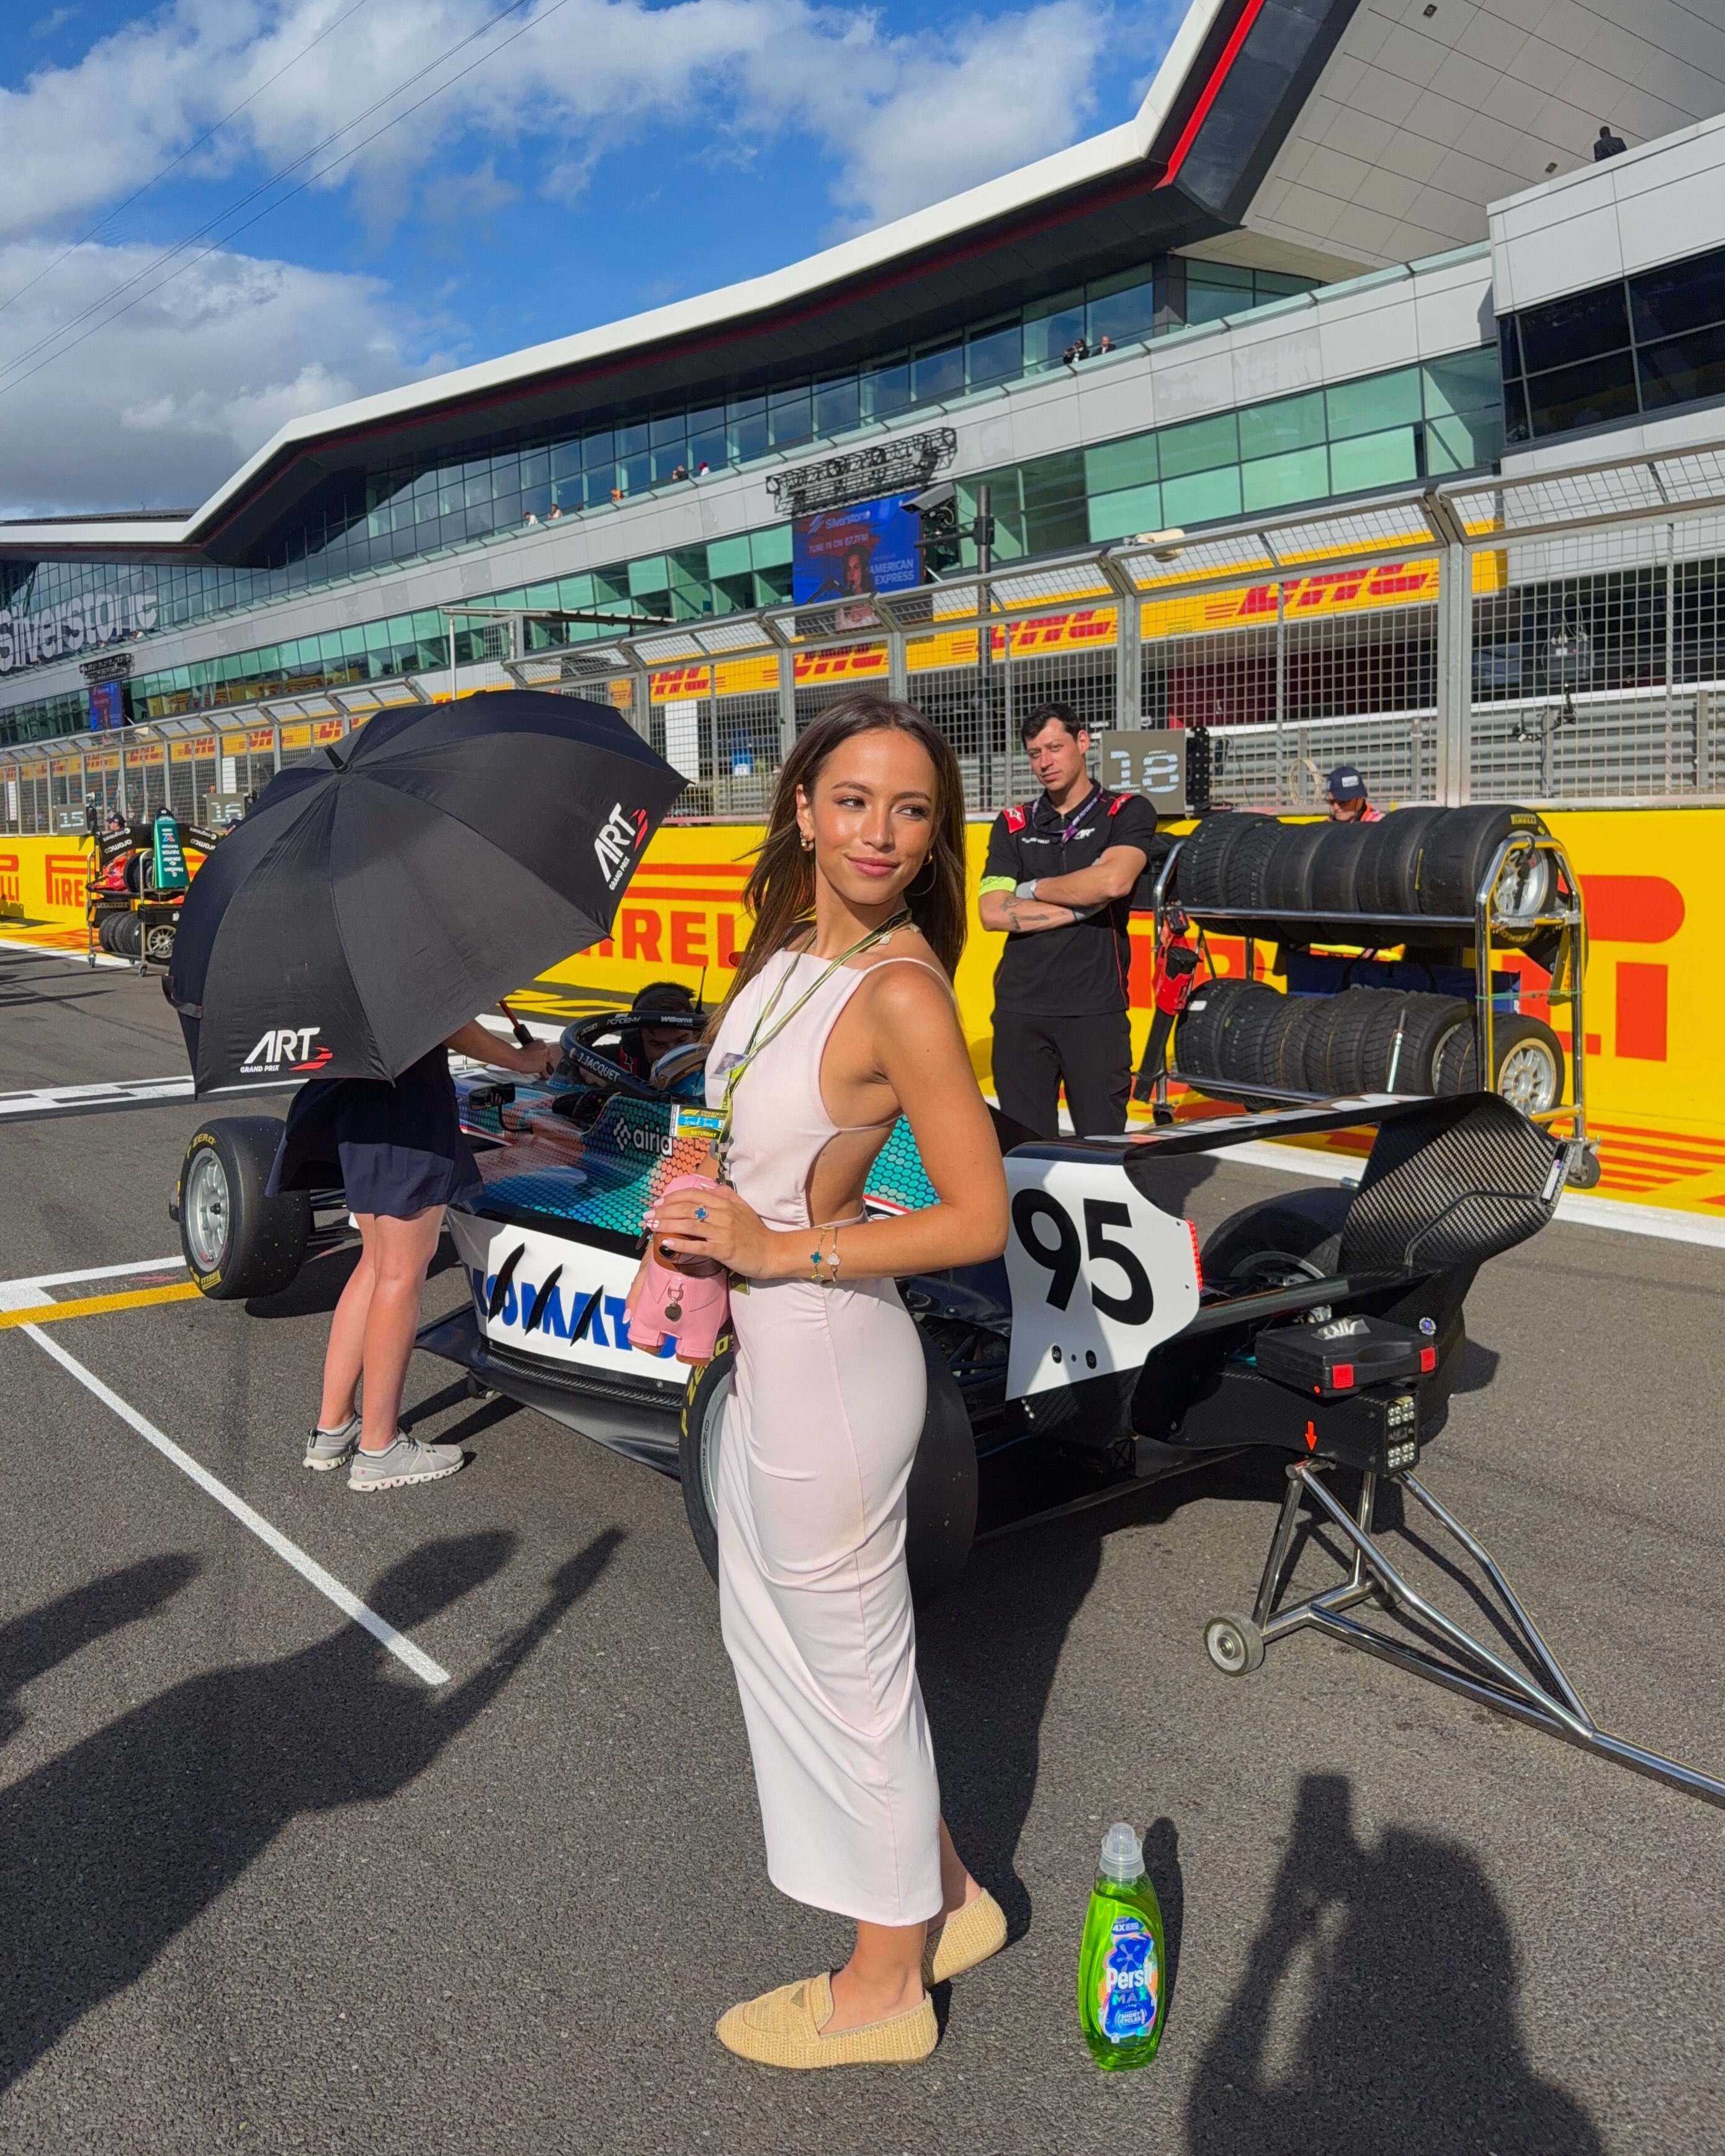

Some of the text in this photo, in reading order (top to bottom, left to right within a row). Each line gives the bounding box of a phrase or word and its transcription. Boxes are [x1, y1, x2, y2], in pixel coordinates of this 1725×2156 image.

[826, 511, 870, 529] Silverstone
[870, 559, 913, 574] AMERICAN
[874, 570, 914, 584] EXPRESS
[1109, 749, 1179, 794] 18
[60, 811, 84, 828] 15
[104, 839, 132, 854] aramco
[594, 802, 635, 882] ART
[609, 856, 630, 890] GRAND PRIX
[607, 1016, 693, 1026] ACADEMY Williams
[244, 1027, 320, 1064] ART
[240, 1065, 263, 1073] GRAND
[577, 1053, 620, 1082] J.JACQUET
[634, 1124, 672, 1156] airia
[691, 1130, 717, 1138] SATURDAY
[1011, 1188, 1154, 1326] 95
[687, 1335, 729, 1407] ZEO
[1112, 1923, 1125, 1932] 4X
[1106, 1962, 1152, 1993] Persil
[1112, 1989, 1148, 2005] MAX
